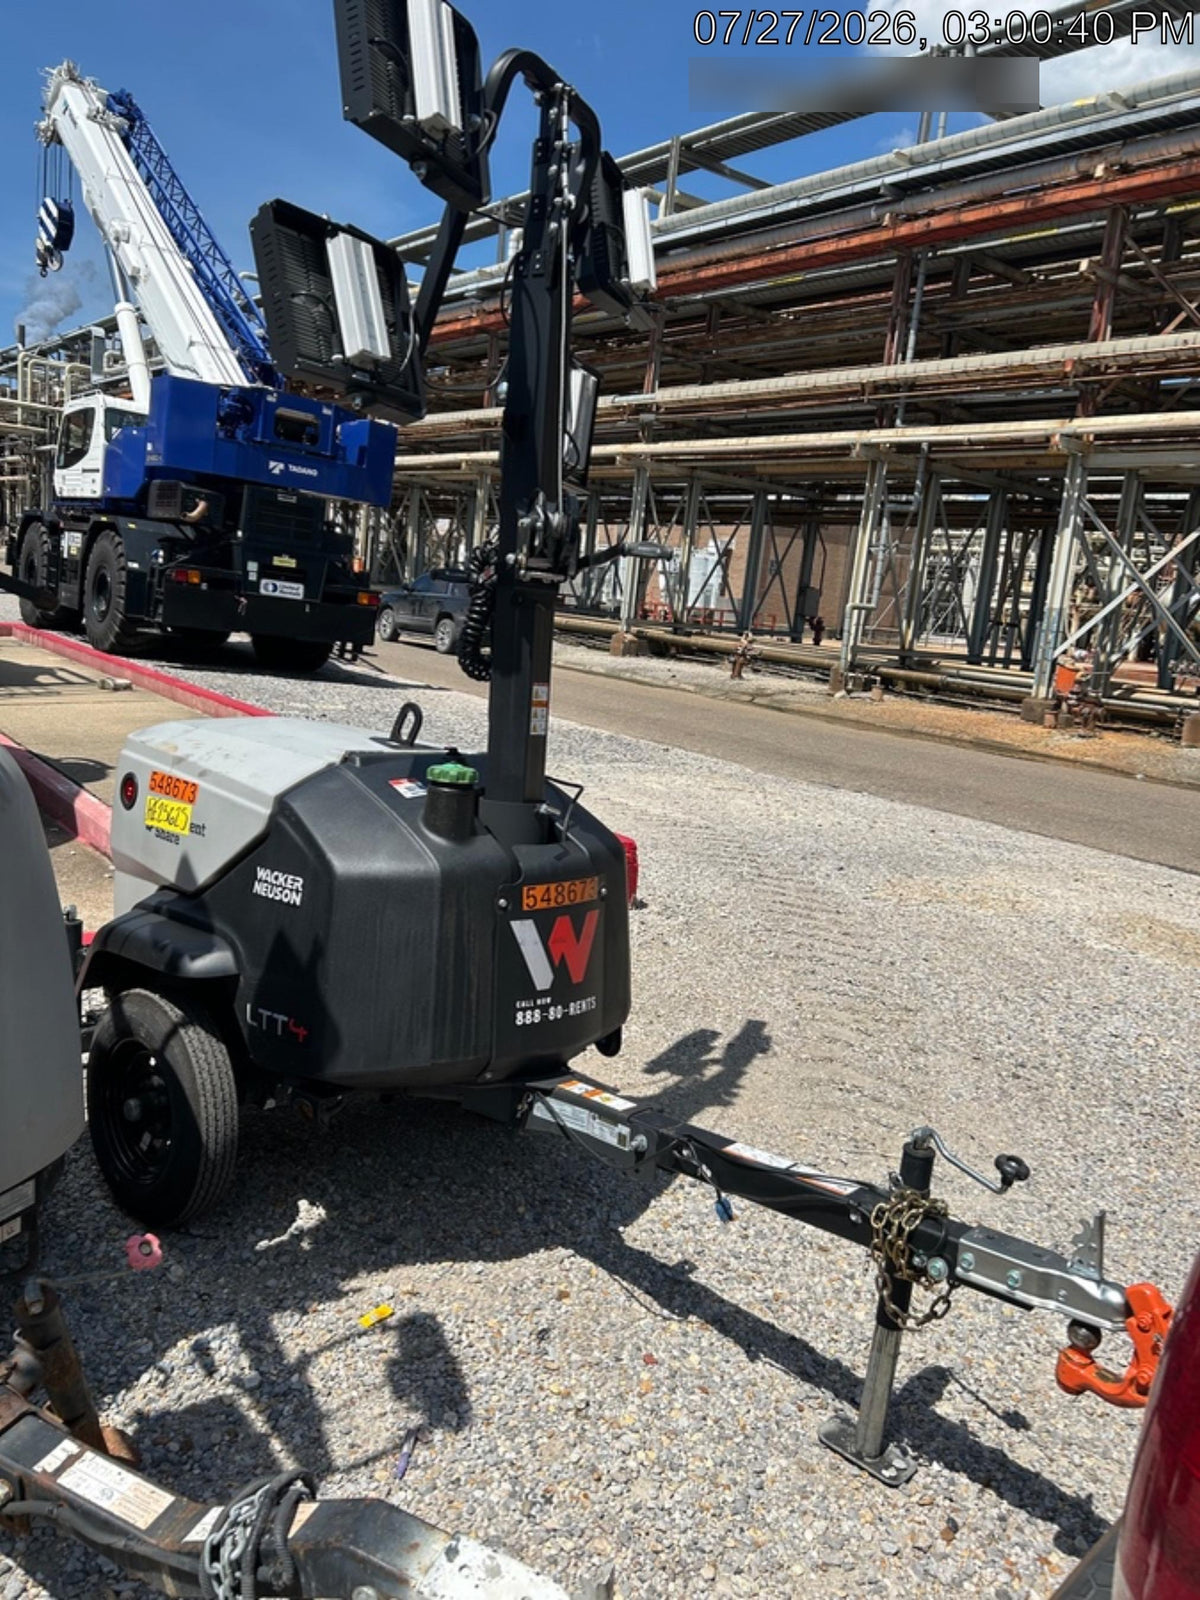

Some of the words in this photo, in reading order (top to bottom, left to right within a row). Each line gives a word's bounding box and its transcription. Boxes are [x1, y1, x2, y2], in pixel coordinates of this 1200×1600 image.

[149, 771, 198, 804] 548673
[252, 879, 303, 906] NEUSON
[257, 866, 303, 892] WACKER
[525, 879, 597, 909] 548673
[246, 1002, 308, 1043] LTT4
